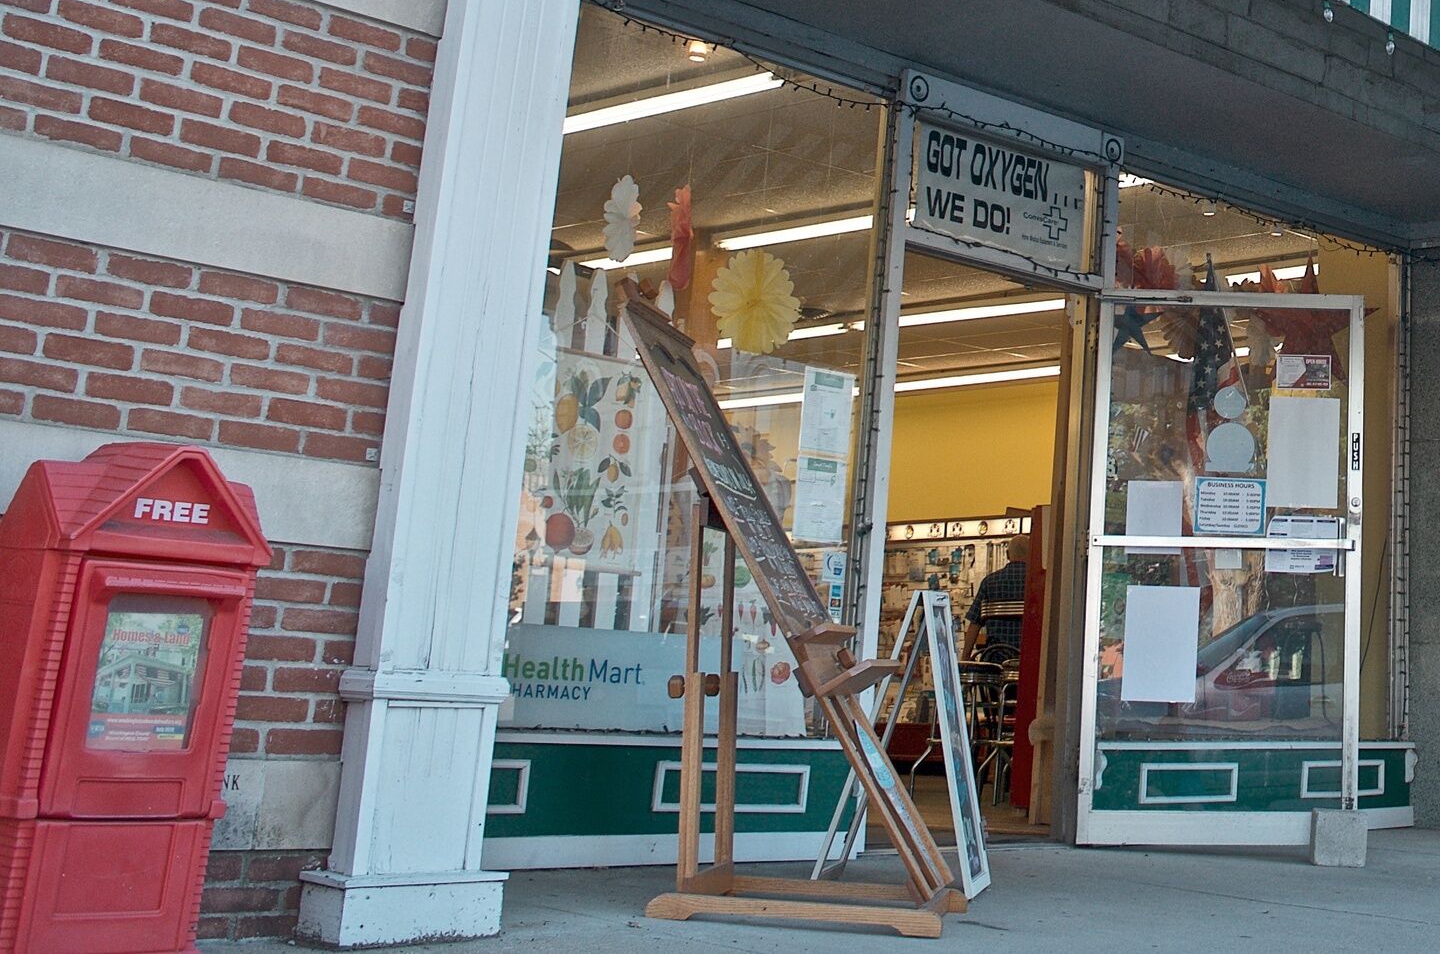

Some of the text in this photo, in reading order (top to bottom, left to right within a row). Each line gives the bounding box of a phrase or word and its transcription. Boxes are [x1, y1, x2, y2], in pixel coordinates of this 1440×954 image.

[926, 130, 1050, 202] GOT OXYGEN
[926, 186, 1011, 235] WE DO!
[134, 498, 211, 524] FREE
[112, 628, 150, 642] Homes
[164, 631, 191, 645] Land
[502, 653, 643, 685] Health Mart
[509, 681, 592, 701] HARMACY
